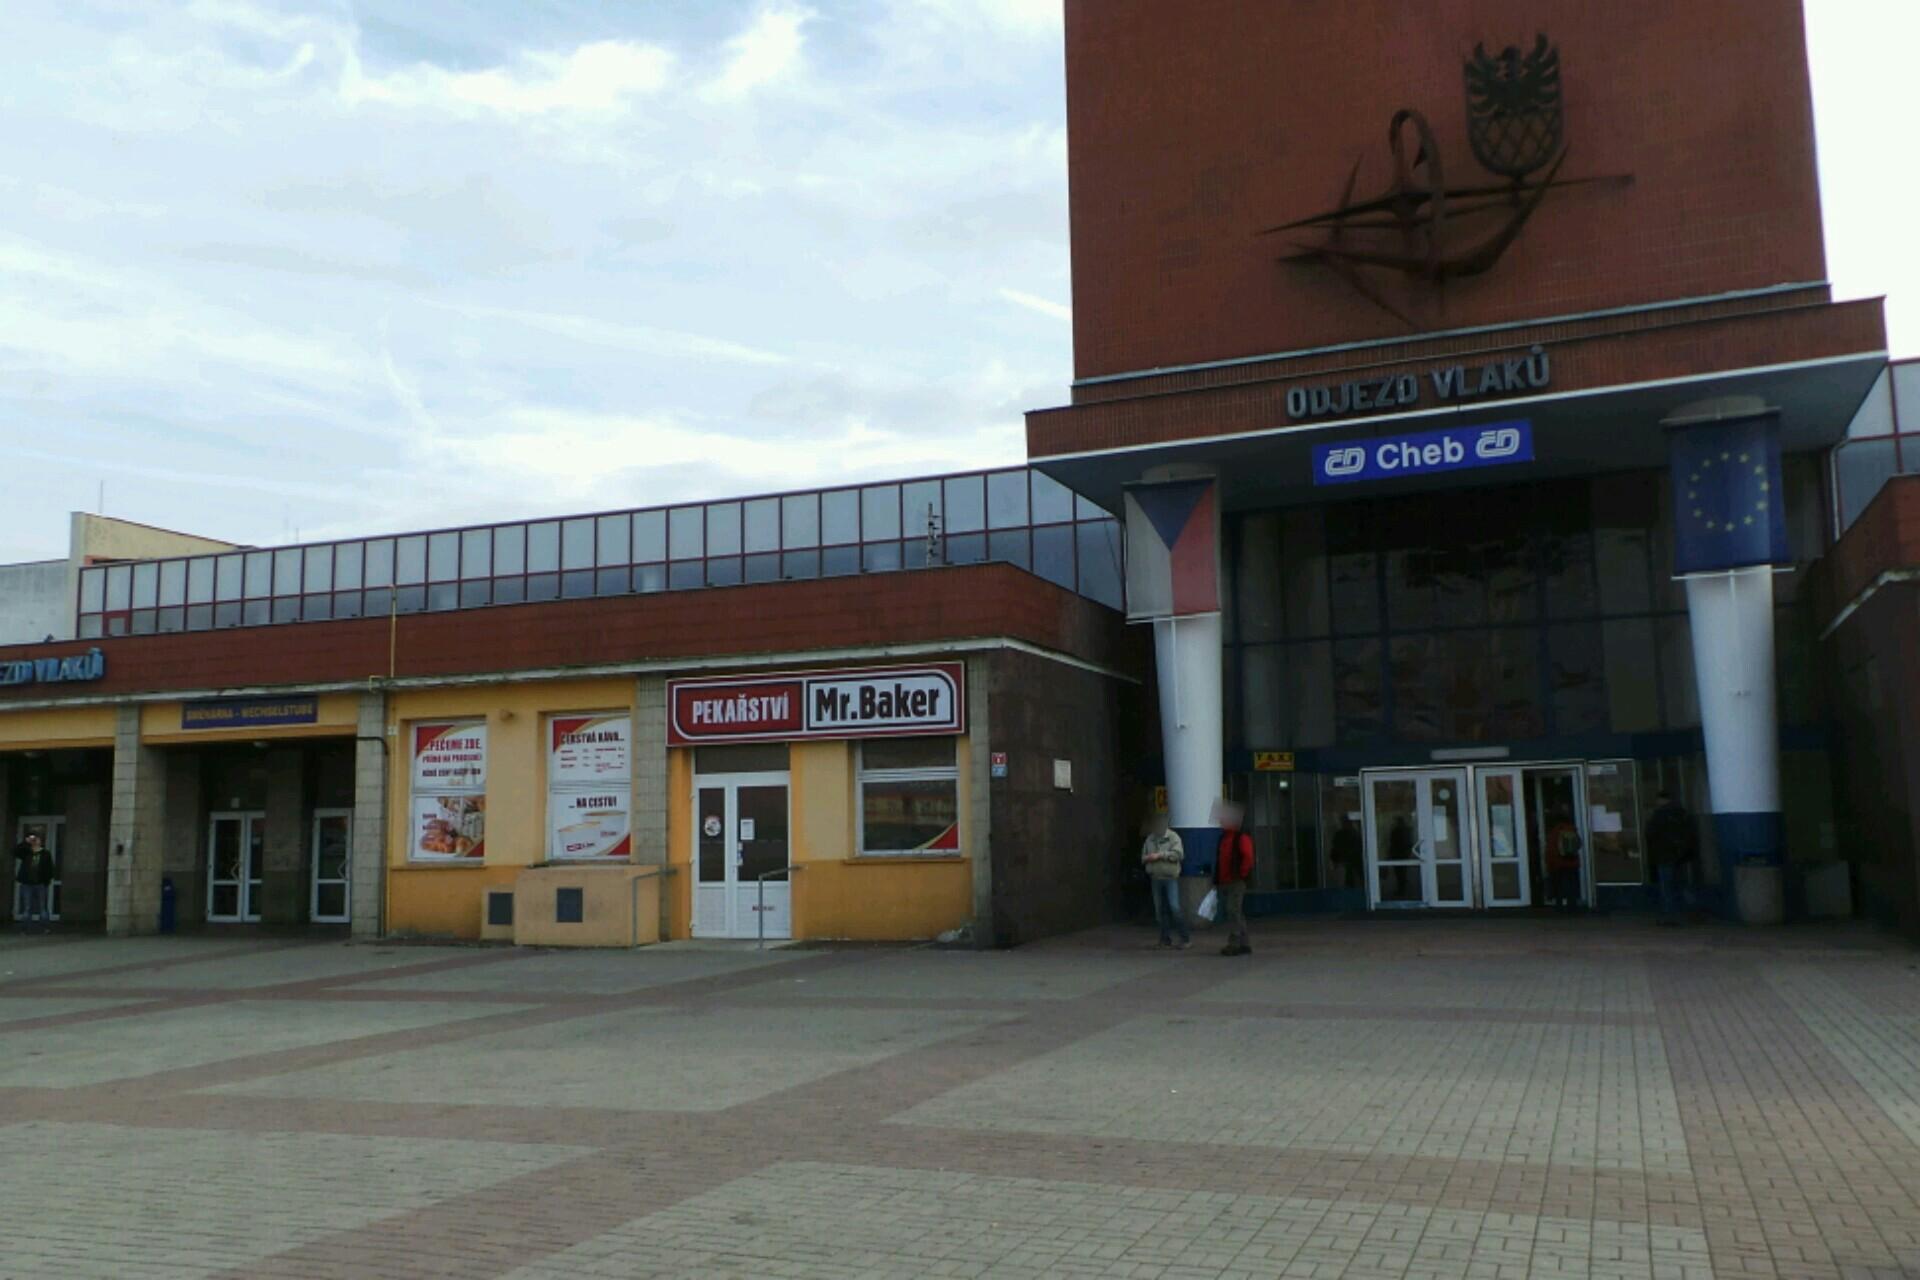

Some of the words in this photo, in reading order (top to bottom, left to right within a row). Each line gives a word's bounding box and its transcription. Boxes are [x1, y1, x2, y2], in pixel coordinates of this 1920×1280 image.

[1286, 374, 1419, 419] ODJEZD
[1432, 344, 1550, 398] VLAKŮ
[1376, 436, 1465, 470] Cheb
[34, 648, 104, 682] VLAKŮ
[692, 691, 790, 724] PEKAŘSTVÍ
[815, 683, 940, 722] Mr.Baker
